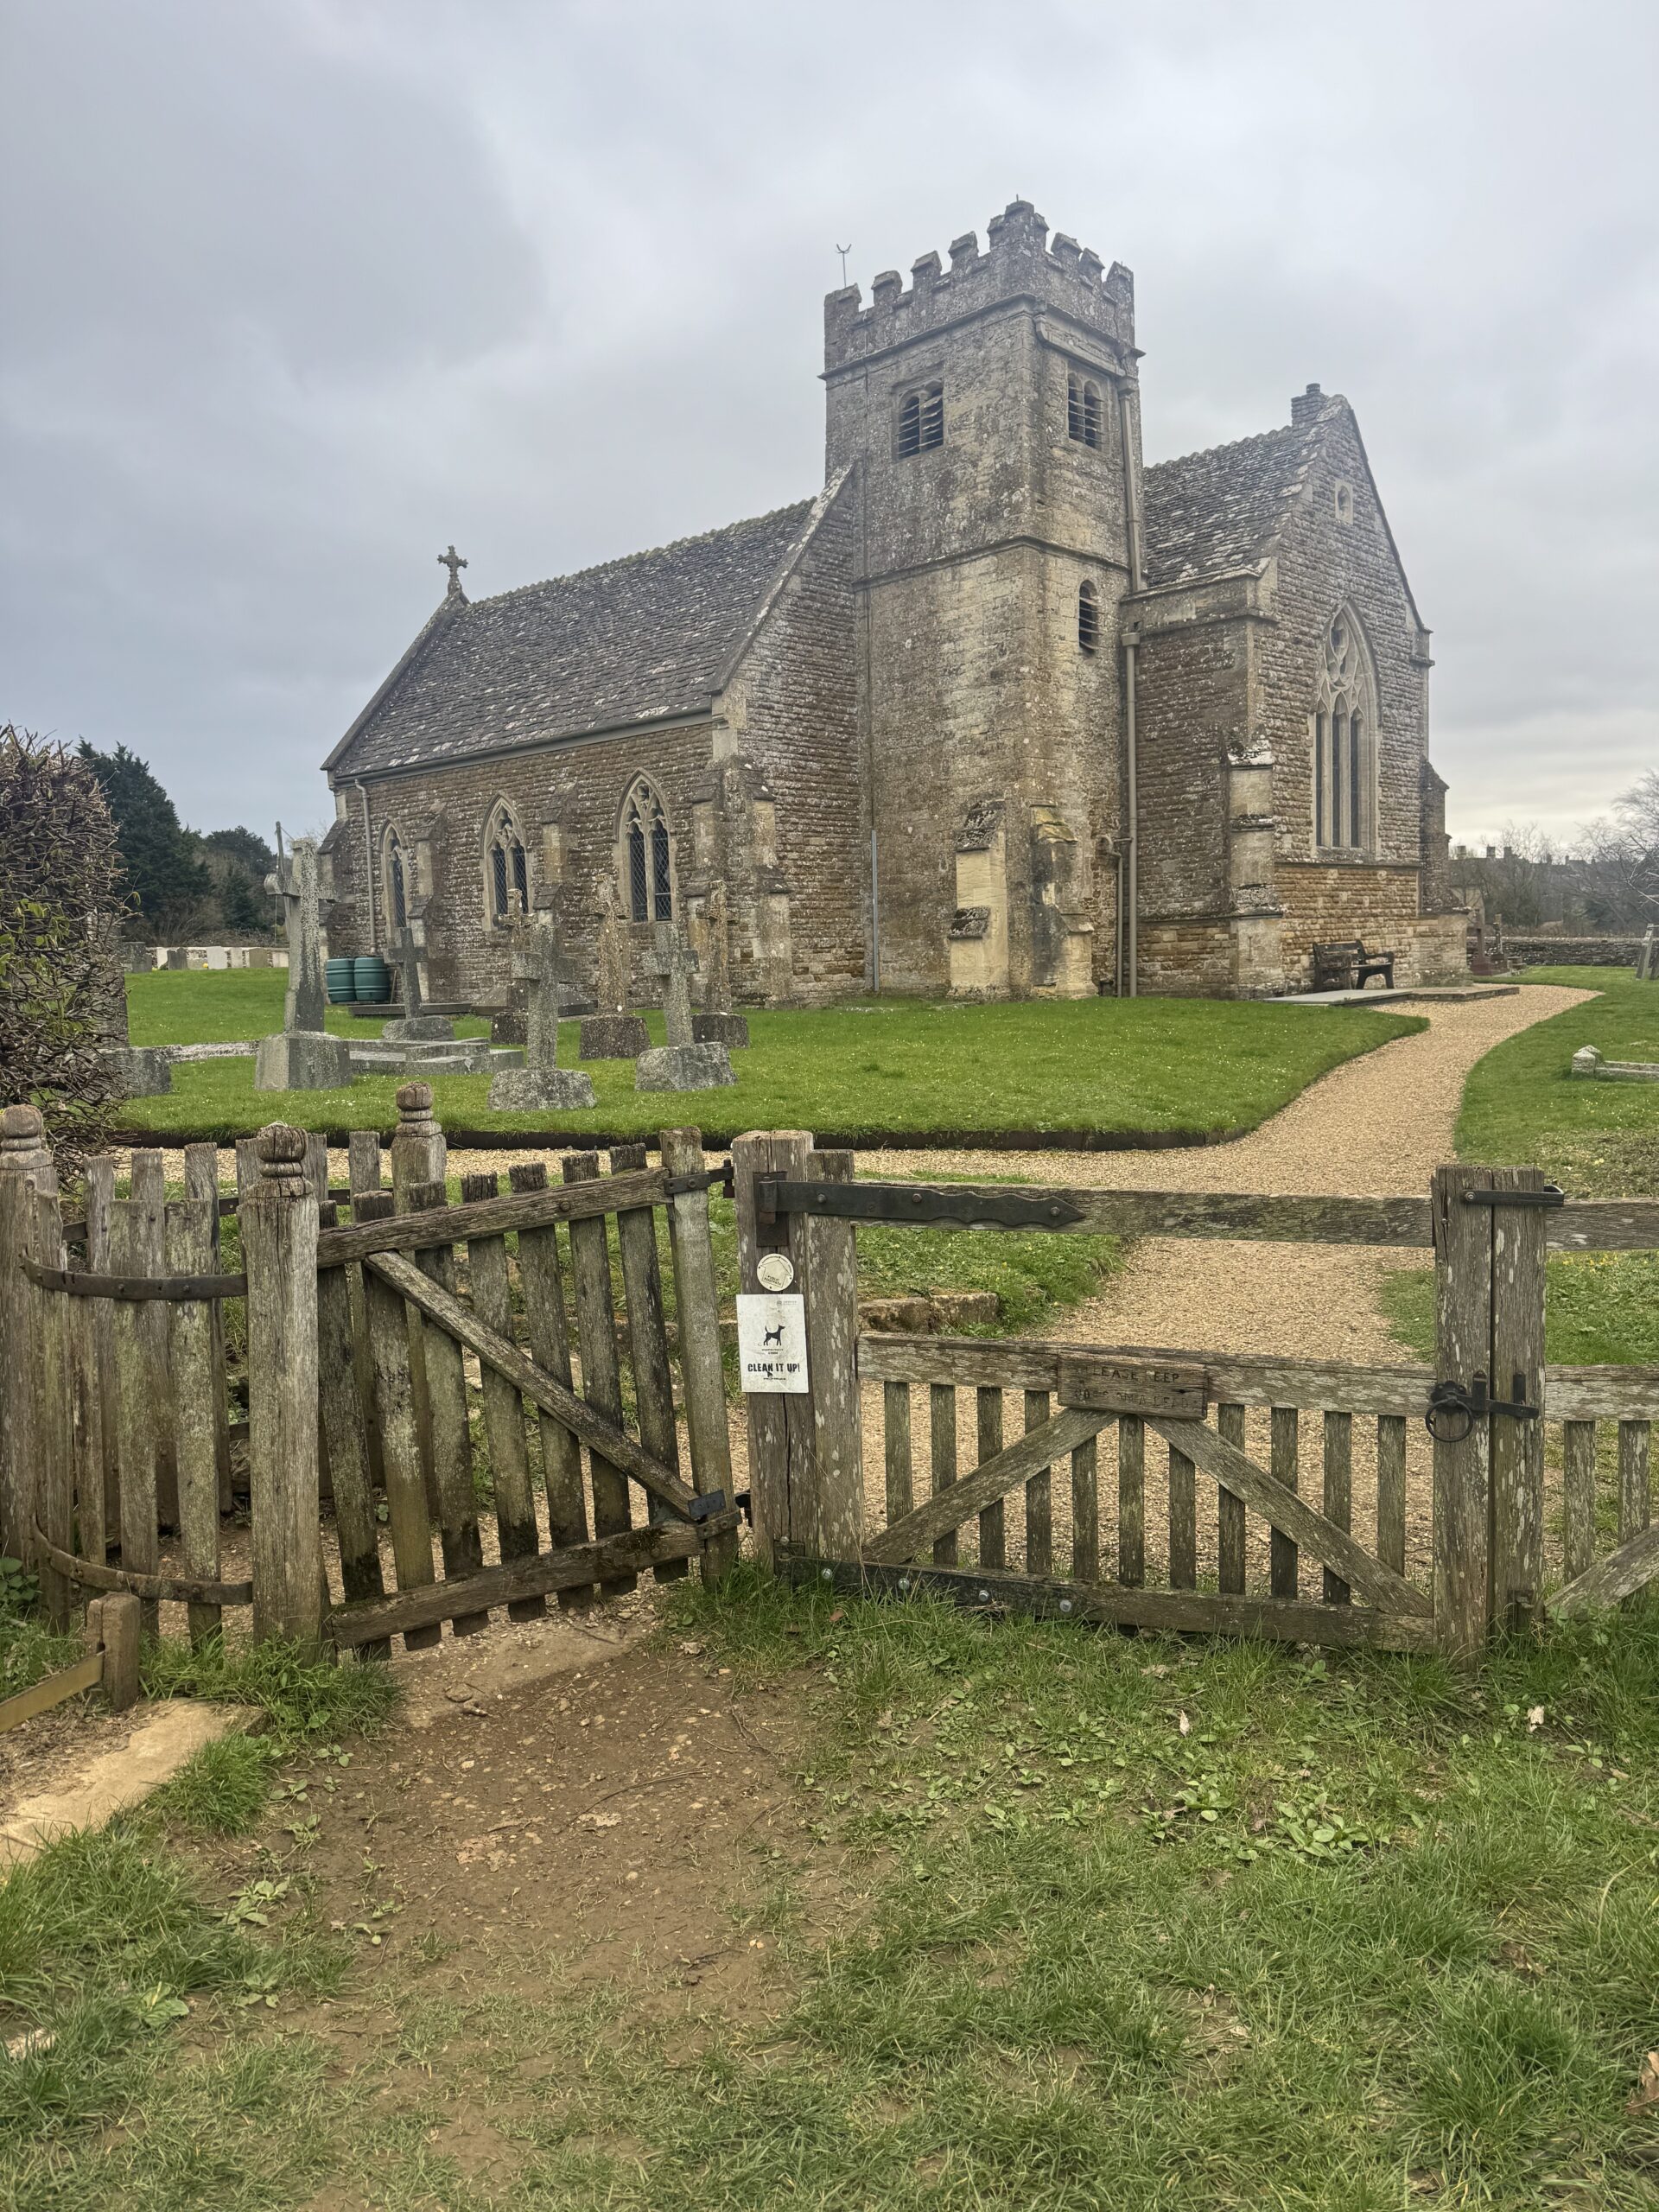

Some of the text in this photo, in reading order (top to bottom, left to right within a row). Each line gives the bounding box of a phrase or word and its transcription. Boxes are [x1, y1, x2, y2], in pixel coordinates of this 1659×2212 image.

[747, 1363, 800, 1373] CLEAN IT UP!
[1085, 1365, 1139, 1382] LEASE
